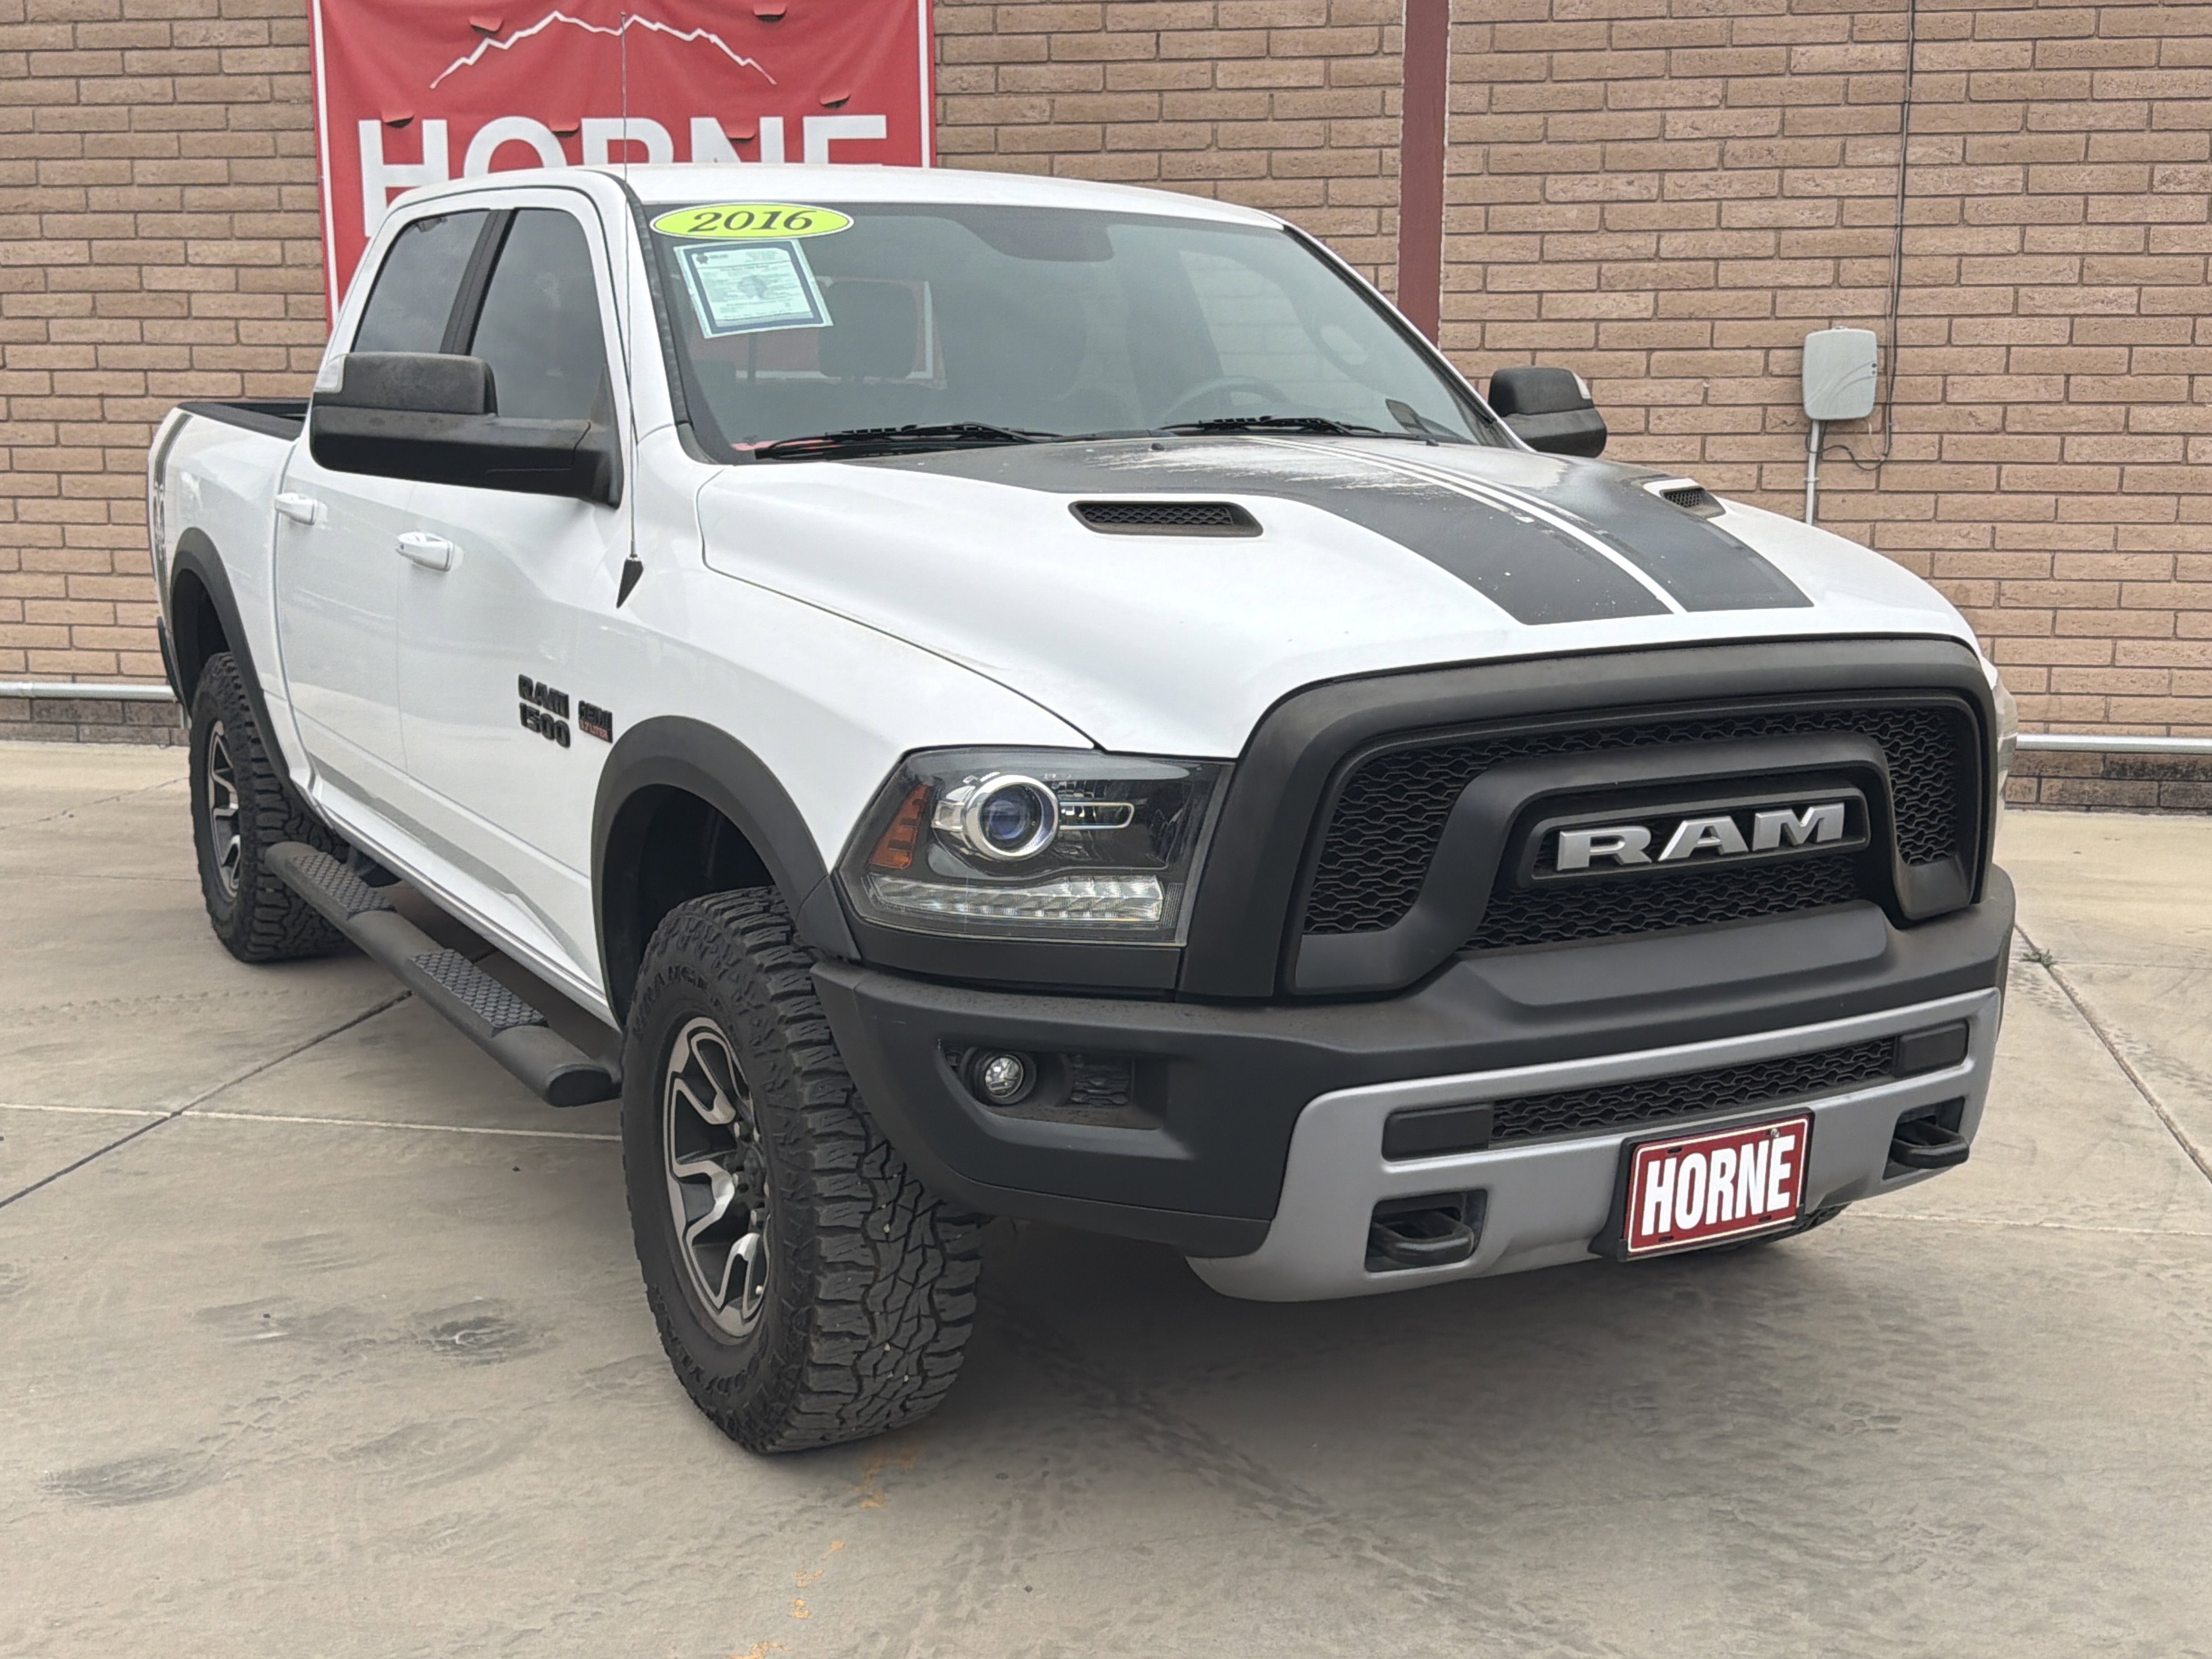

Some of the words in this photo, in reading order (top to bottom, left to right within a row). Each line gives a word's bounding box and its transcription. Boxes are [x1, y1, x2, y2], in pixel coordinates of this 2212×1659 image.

[687, 210, 817, 233] 2016
[518, 674, 569, 720] RAM
[520, 702, 571, 748] 1500
[1557, 802, 1845, 871] RAM
[1641, 1135, 1796, 1236] HORNE
